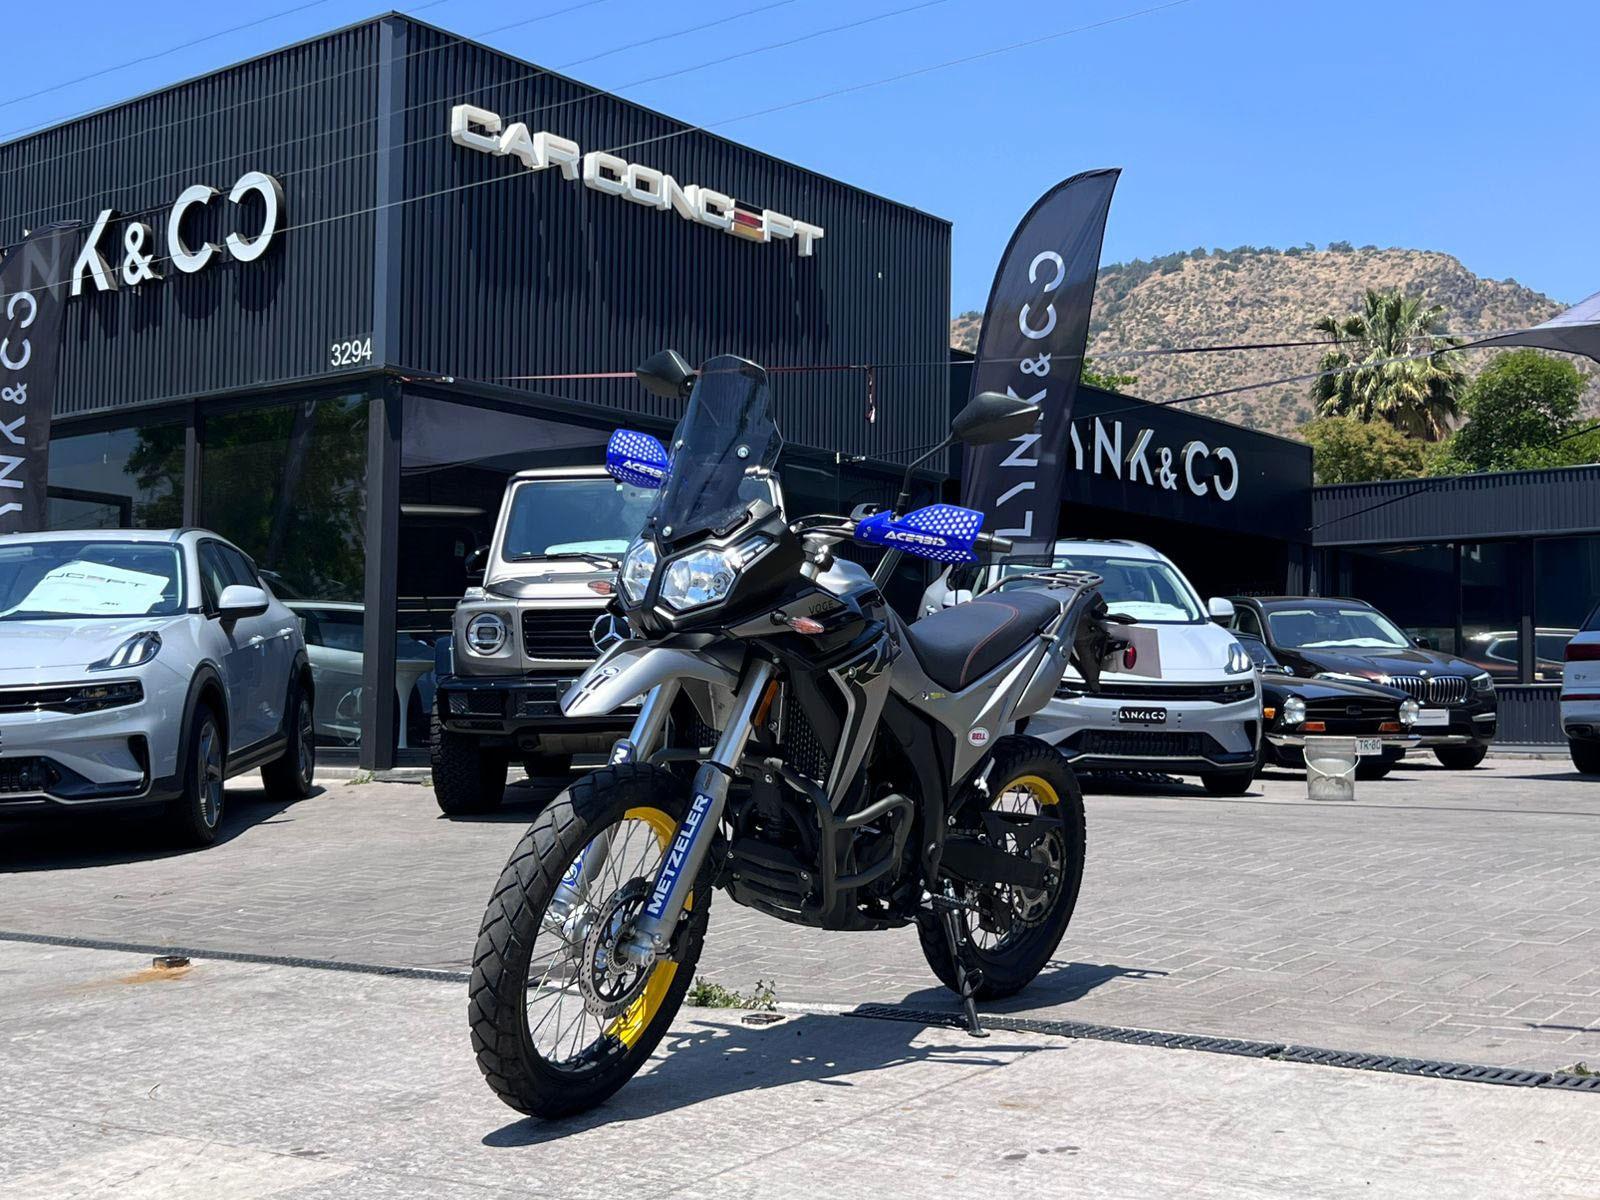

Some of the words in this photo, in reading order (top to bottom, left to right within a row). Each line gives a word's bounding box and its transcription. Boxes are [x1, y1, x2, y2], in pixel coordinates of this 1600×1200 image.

[331, 337, 372, 367] 3294
[971, 732, 986, 741] BELL
[647, 794, 709, 915] METZELER
